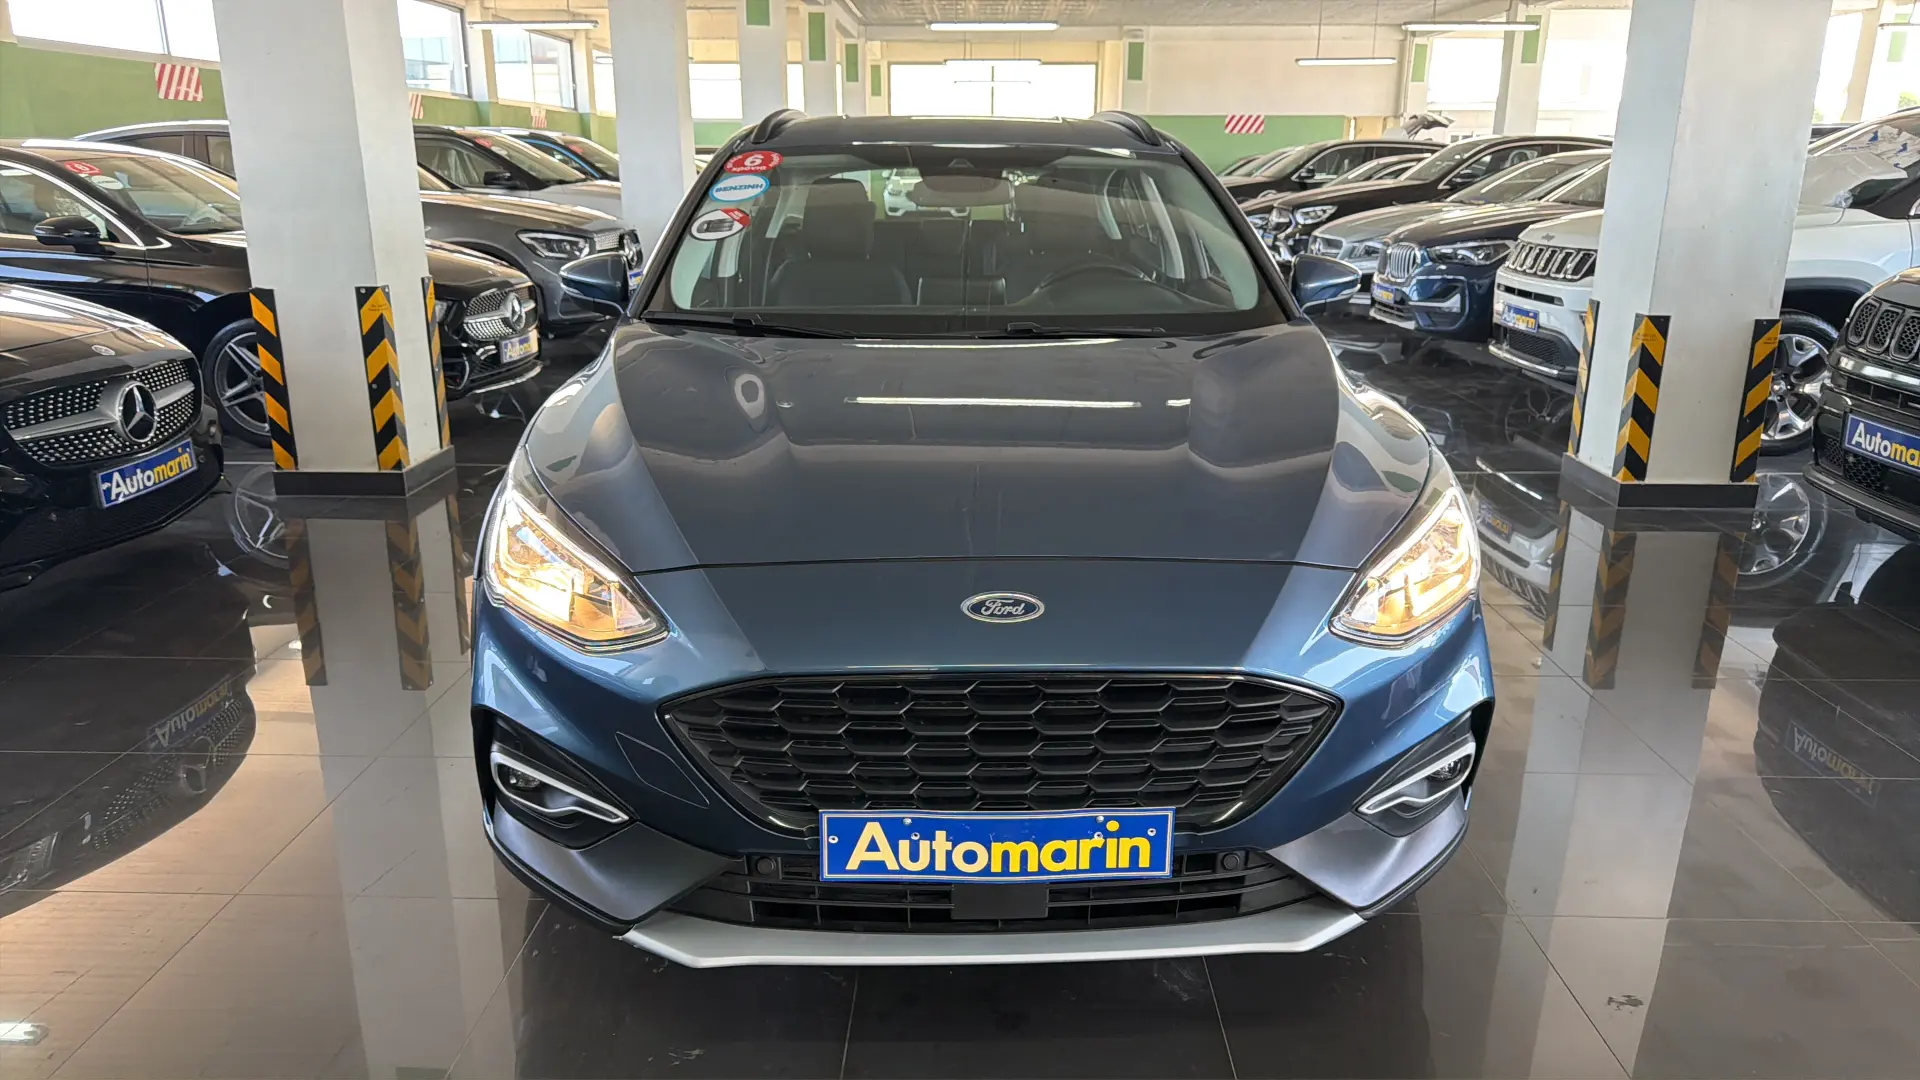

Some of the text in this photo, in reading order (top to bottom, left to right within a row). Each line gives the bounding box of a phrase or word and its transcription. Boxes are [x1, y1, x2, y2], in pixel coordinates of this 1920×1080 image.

[744, 154, 765, 167] 6
[111, 447, 192, 501] Automarin
[981, 599, 1026, 616] Ford
[845, 820, 1151, 873] Automarin
